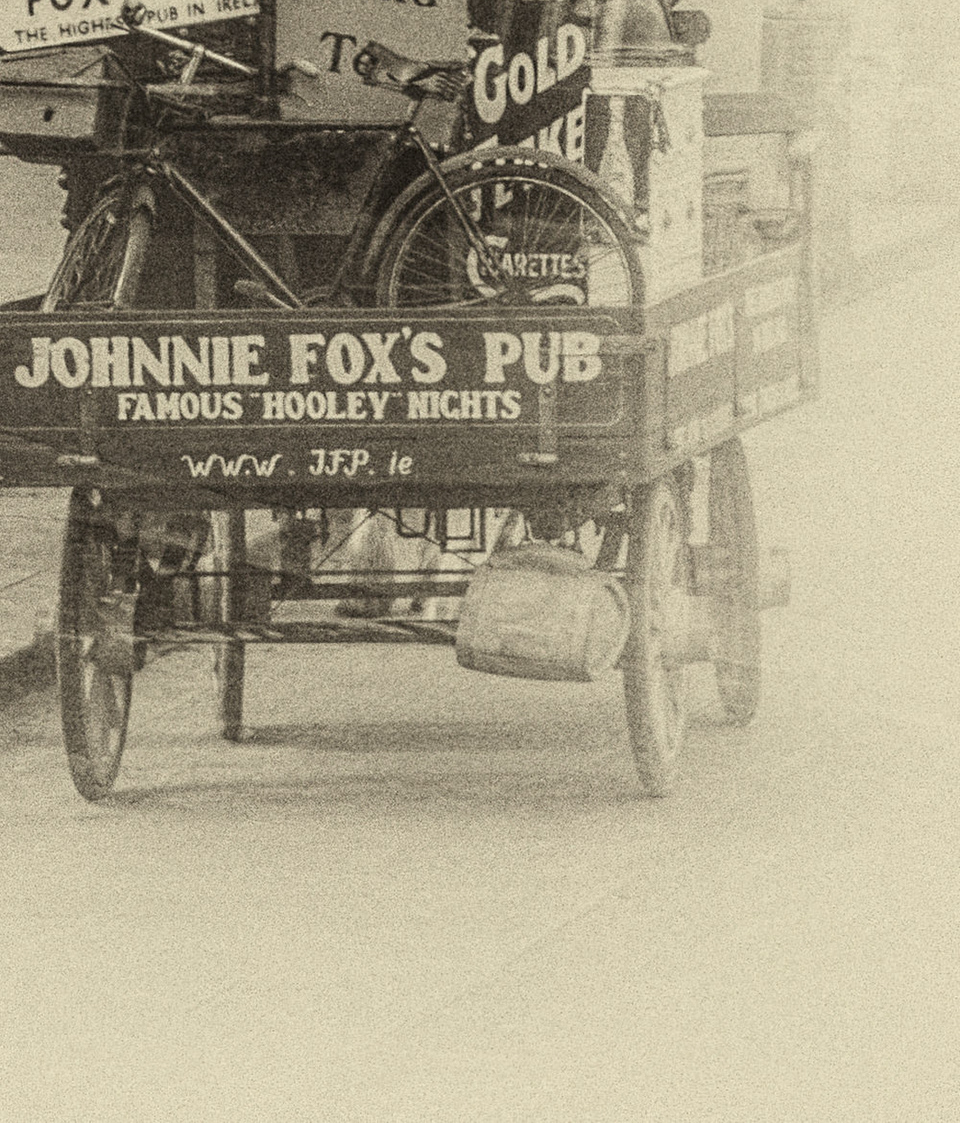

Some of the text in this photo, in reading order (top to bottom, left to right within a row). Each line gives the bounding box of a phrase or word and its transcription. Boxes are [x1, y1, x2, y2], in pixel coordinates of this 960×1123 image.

[14, 26, 47, 43] THE
[146, 6, 179, 23] PUB
[187, 1, 206, 17] IN
[320, 30, 380, 80] Te
[473, 23, 586, 124] GOLD
[14, 326, 603, 389] JOHNNIE FOX'S PUB
[117, 390, 244, 421] FAMOUS
